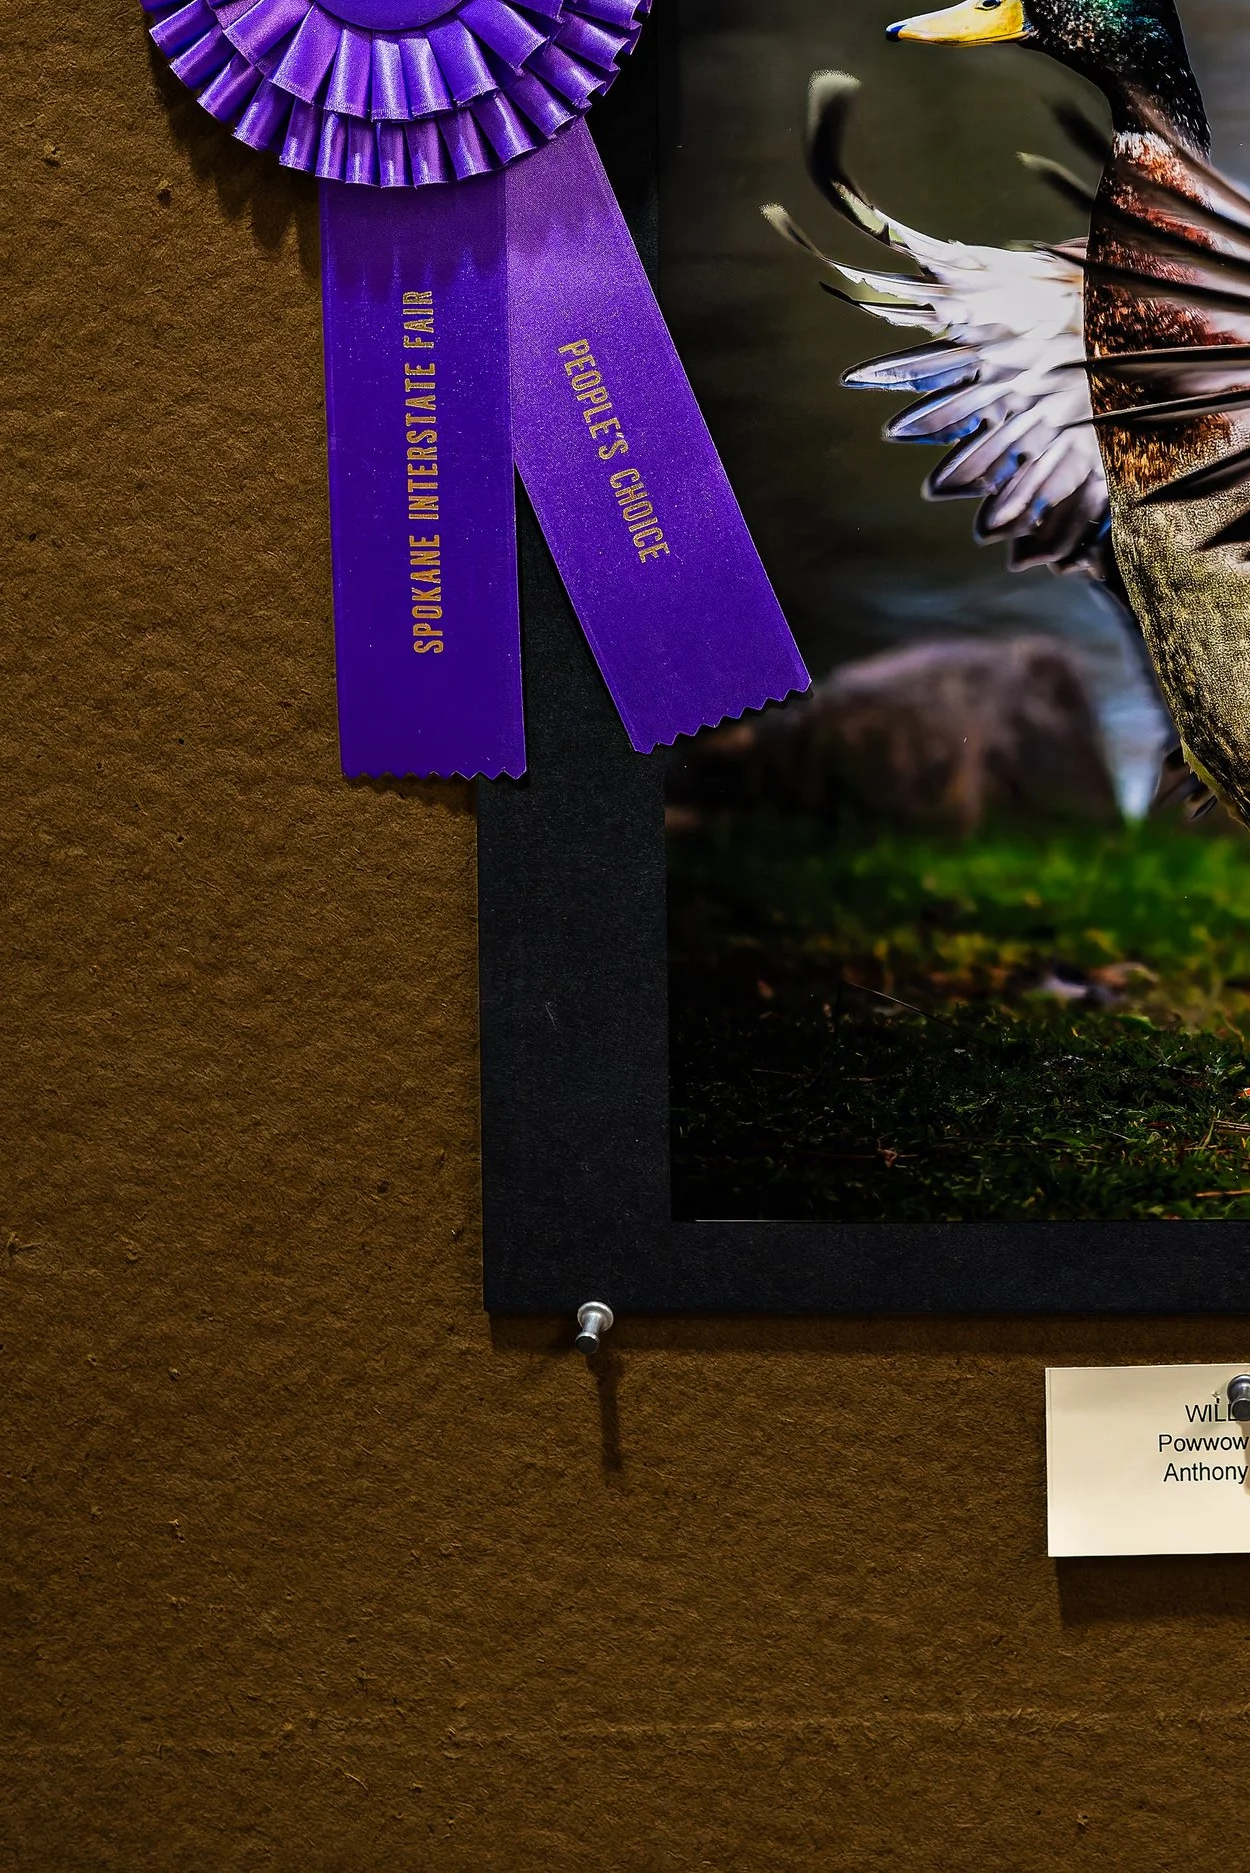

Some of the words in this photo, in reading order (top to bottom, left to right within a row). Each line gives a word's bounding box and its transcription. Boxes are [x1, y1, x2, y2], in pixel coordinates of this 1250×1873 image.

[403, 290, 435, 349] FAIR
[404, 362, 439, 521] INTERSTATE
[558, 338, 629, 460] PEOPLE'S
[610, 468, 671, 563] CHOICE
[409, 534, 444, 654] SPOKANE
[1158, 1434, 1248, 1452] Powwow
[1163, 1462, 1248, 1484] Anthony
